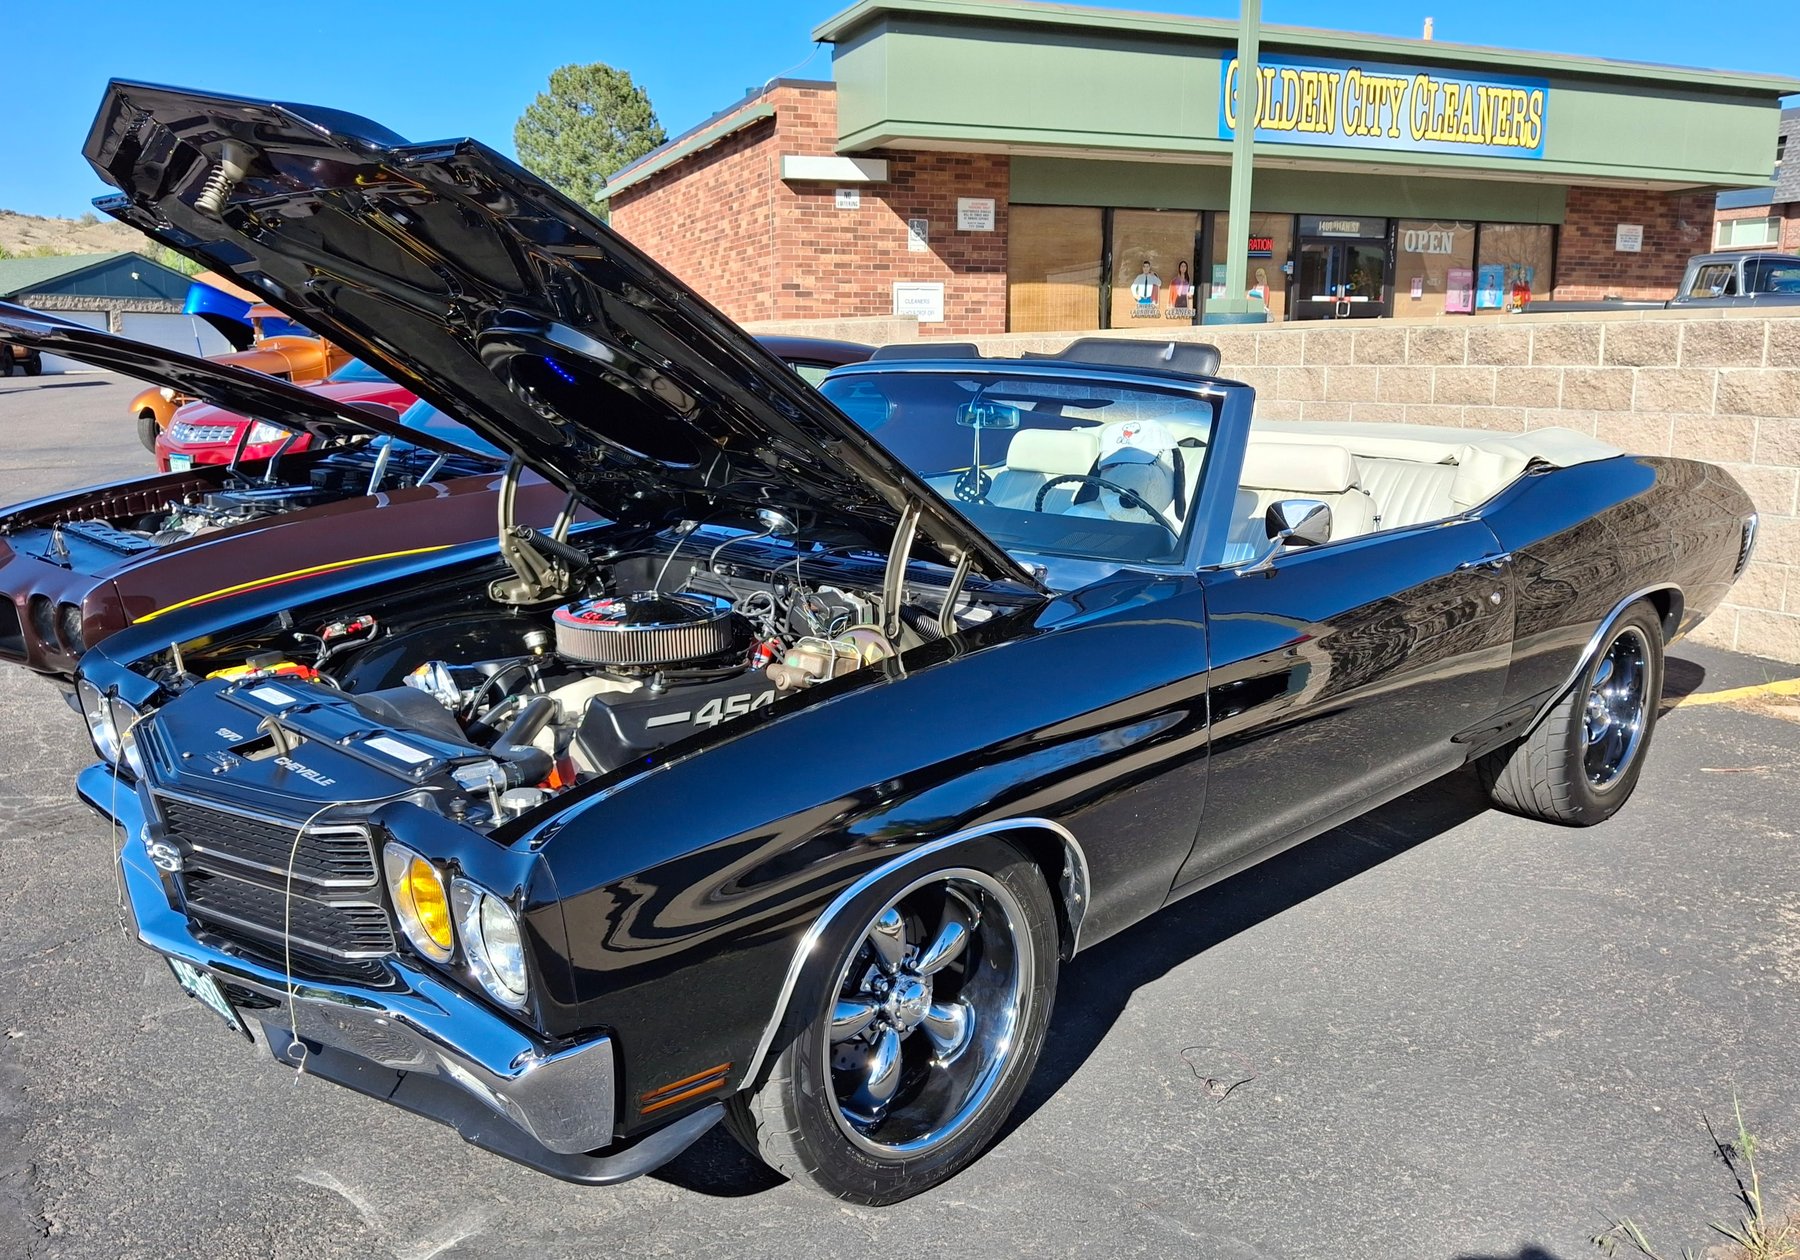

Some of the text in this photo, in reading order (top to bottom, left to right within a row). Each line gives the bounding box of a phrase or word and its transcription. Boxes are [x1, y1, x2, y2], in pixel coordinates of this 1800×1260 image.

[1342, 67, 1408, 138] CITY
[1409, 73, 1544, 150] CLEANERS
[1249, 238, 1274, 251] RATION
[1404, 230, 1454, 254] OPEN
[694, 689, 776, 728] 454
[215, 727, 244, 742] 1970
[274, 756, 337, 787] CHEVELLE
